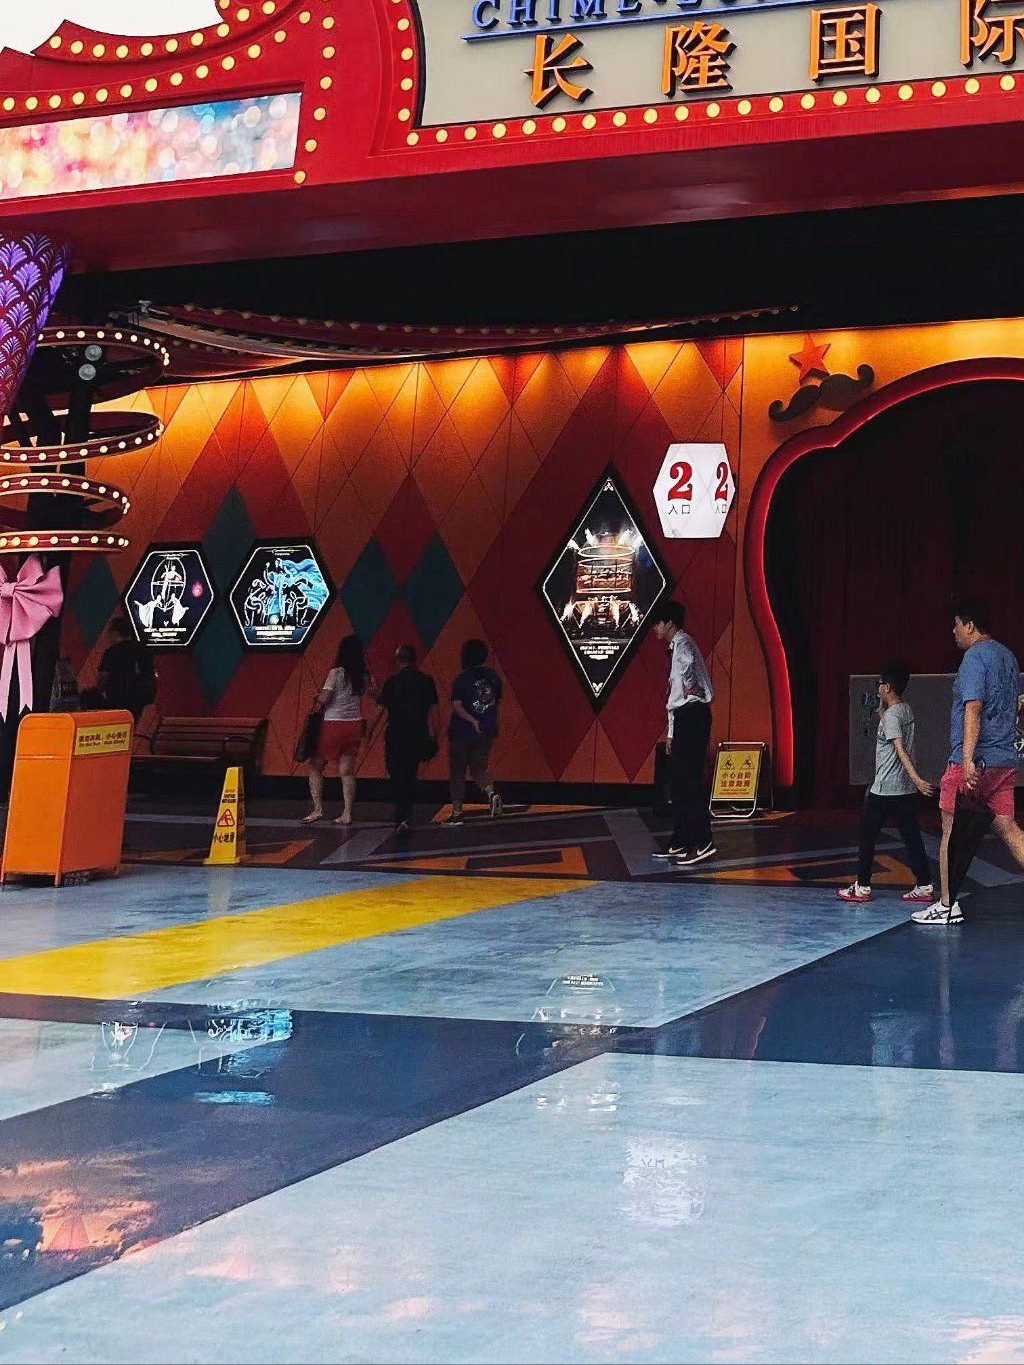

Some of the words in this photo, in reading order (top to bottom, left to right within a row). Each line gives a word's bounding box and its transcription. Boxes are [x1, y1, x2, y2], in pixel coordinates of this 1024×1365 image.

[667, 462, 693, 501] 2
[715, 462, 728, 501] 2
[668, 504, 691, 515] 入口
